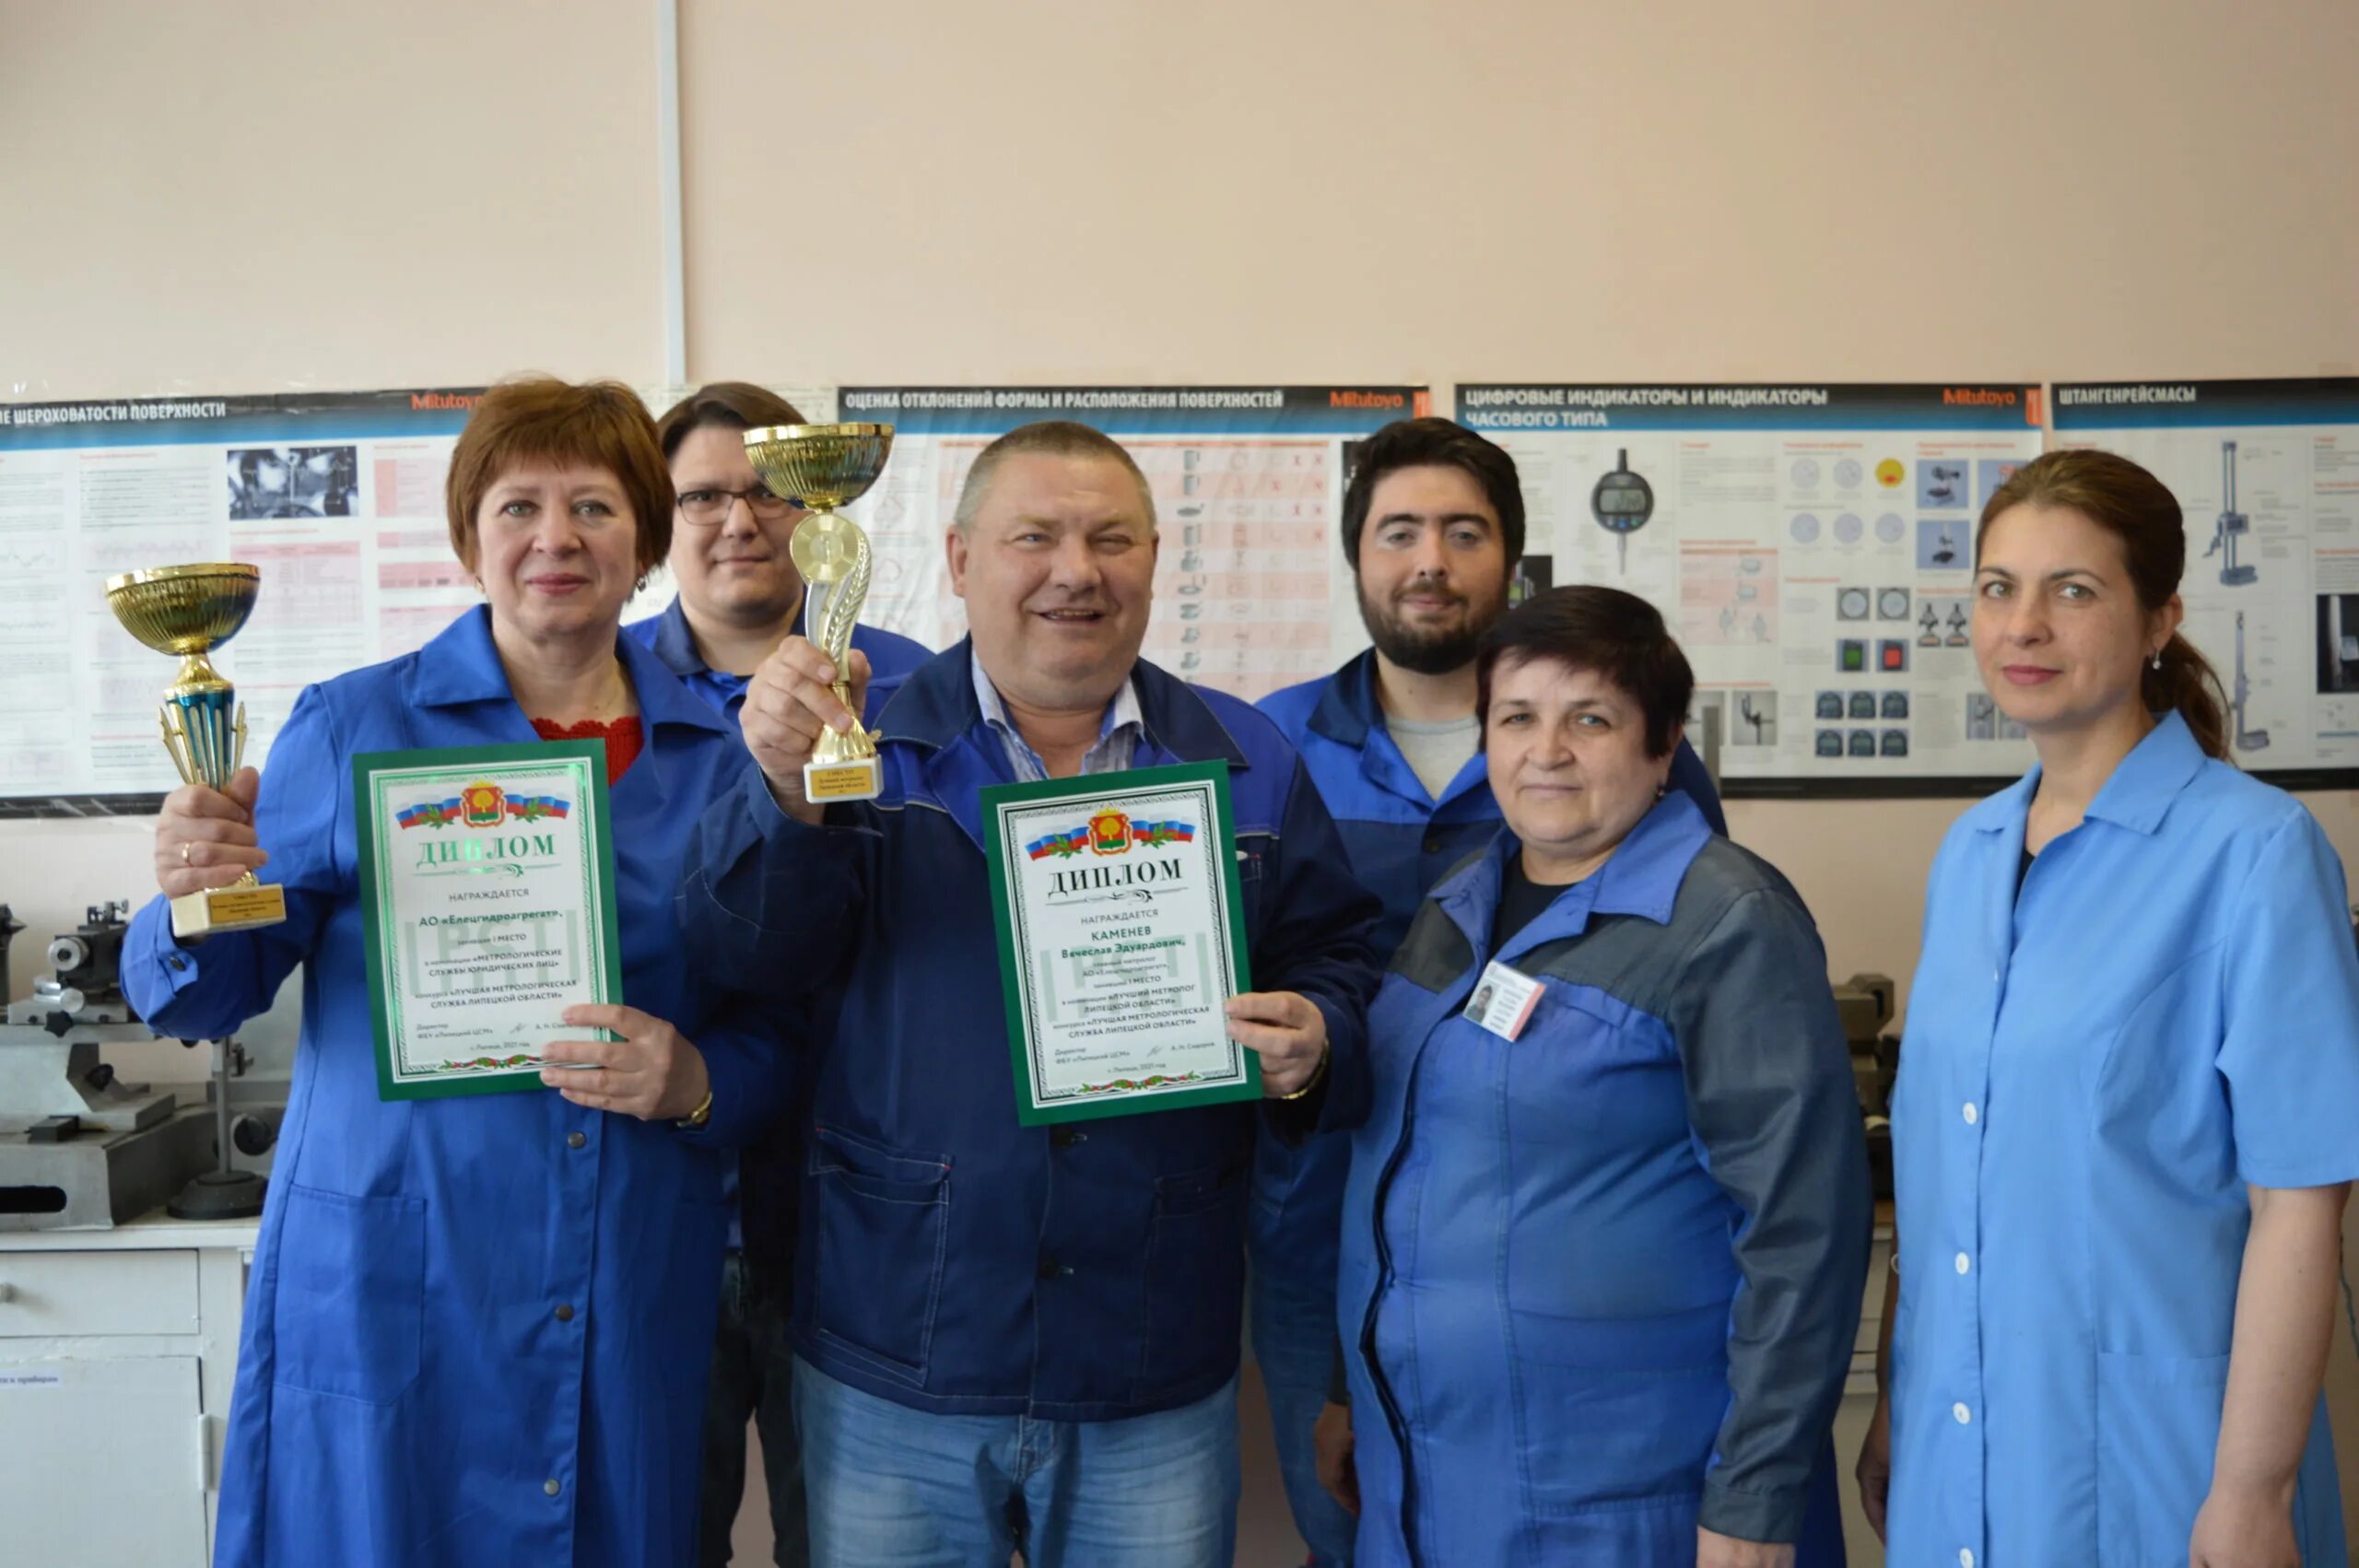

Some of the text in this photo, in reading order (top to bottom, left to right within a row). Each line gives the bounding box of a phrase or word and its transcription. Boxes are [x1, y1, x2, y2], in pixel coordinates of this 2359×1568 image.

[845, 390, 1285, 410] ОЦЕНКА ОТКЛОНЕНИЙ ФОРМЫ И РАСПОЛОЖЕНИЯ ПОВЕРХНОСТЕЙ
[1330, 391, 1403, 410] Mitutoyo
[1465, 389, 1828, 408] ЦИФРОВЫЕ ИНДИКАТОРЫ И ИНДИКАТОРЫ
[1942, 388, 2015, 407] Mitutoyo
[2059, 384, 2197, 405] ШТАНГЕНРЕЙСМАСЫ
[13, 405, 128, 425] ШЕРОХОВАТОСТИ
[130, 403, 226, 421] ПОВЕРХНОСТИ
[1465, 410, 1608, 428] ЧАСОВОГО ТИПА
[417, 834, 556, 869] ДИПЛОМ
[1047, 858, 1183, 899] ДИПЛОМ
[449, 888, 530, 903] НАГРАЖДАЕТСЯ
[418, 916, 438, 927] АО
[1080, 909, 1158, 925] НАГРАЖДАЕТСЯ
[1091, 926, 1152, 942] КАМЕНЕВ
